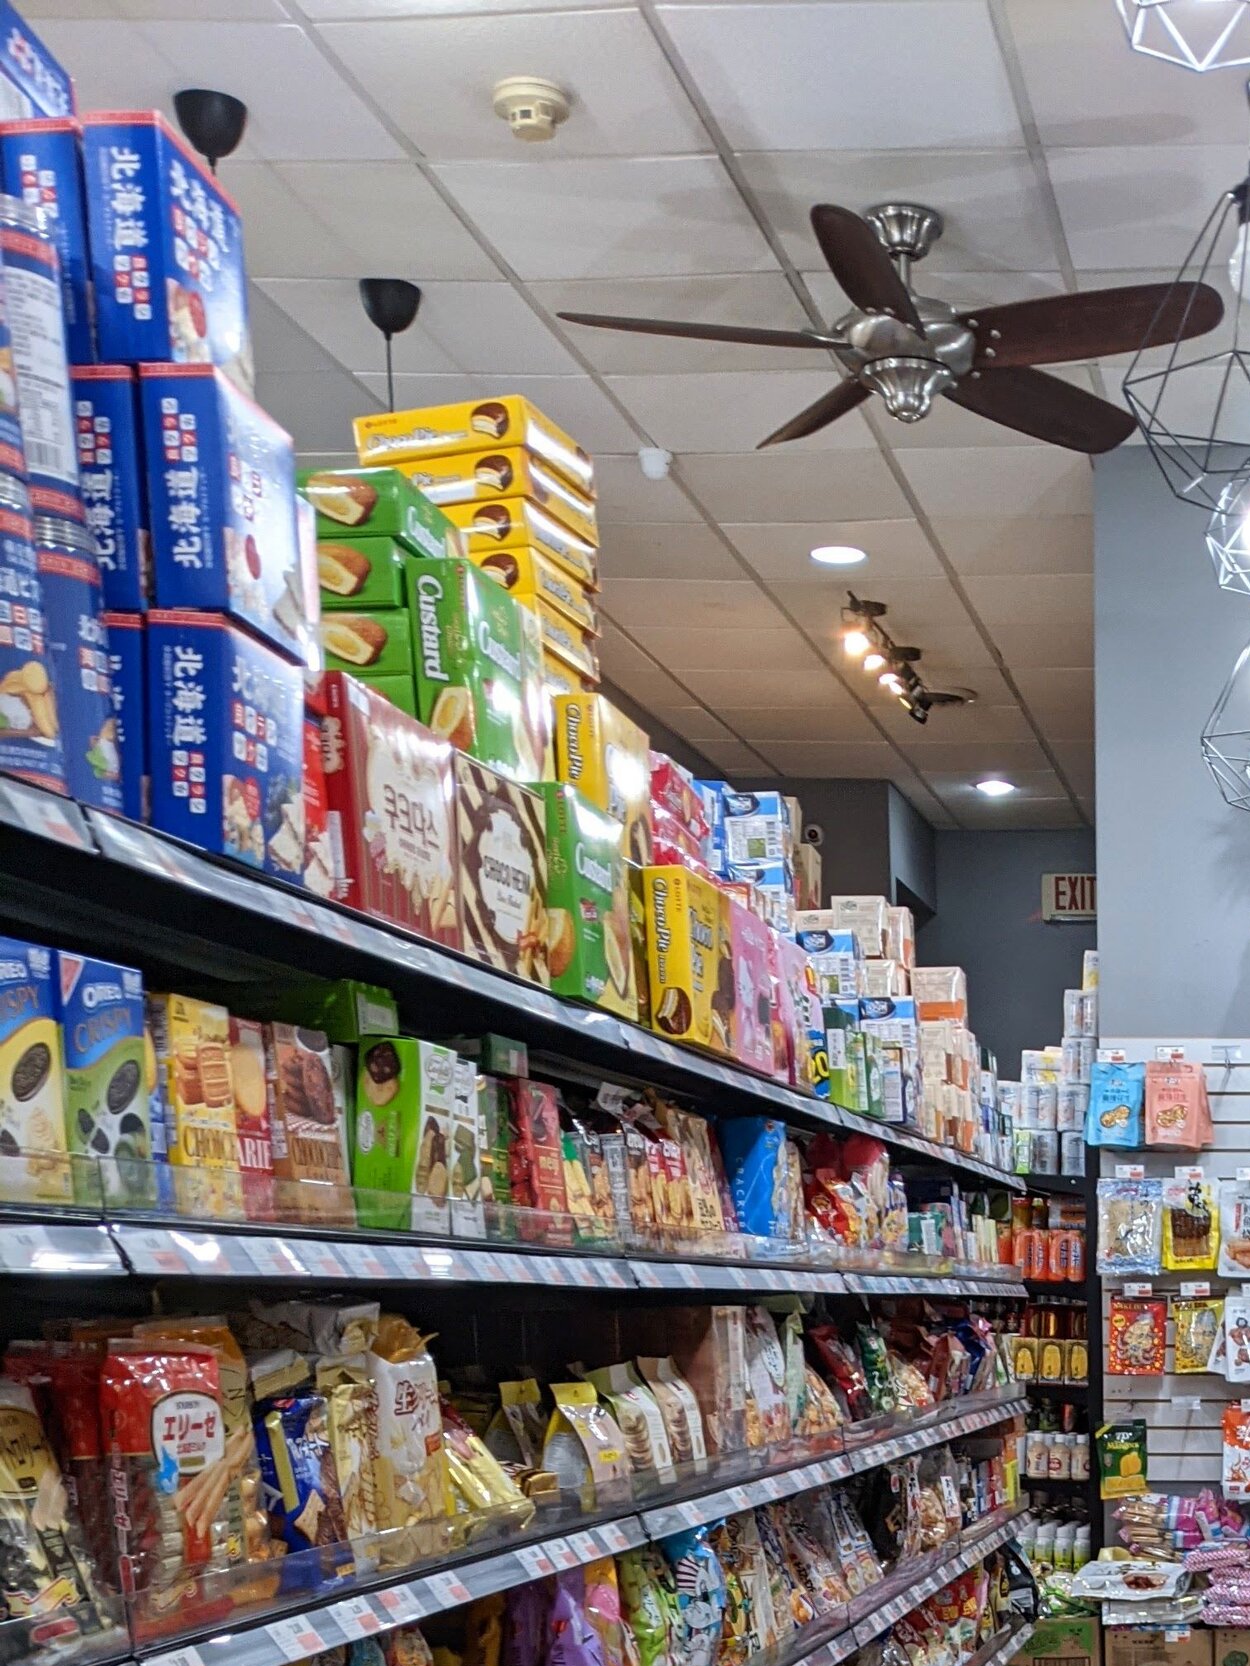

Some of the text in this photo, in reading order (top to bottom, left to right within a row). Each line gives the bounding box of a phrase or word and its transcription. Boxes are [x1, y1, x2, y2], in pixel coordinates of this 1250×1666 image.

[165, 466, 202, 568] 北海道
[416, 573, 450, 682] Custard
[172, 645, 208, 746] 北海道
[82, 983, 123, 1009] OREO
[237, 1135, 274, 1170] ARIE
[162, 1411, 217, 1442] エリーゼ
